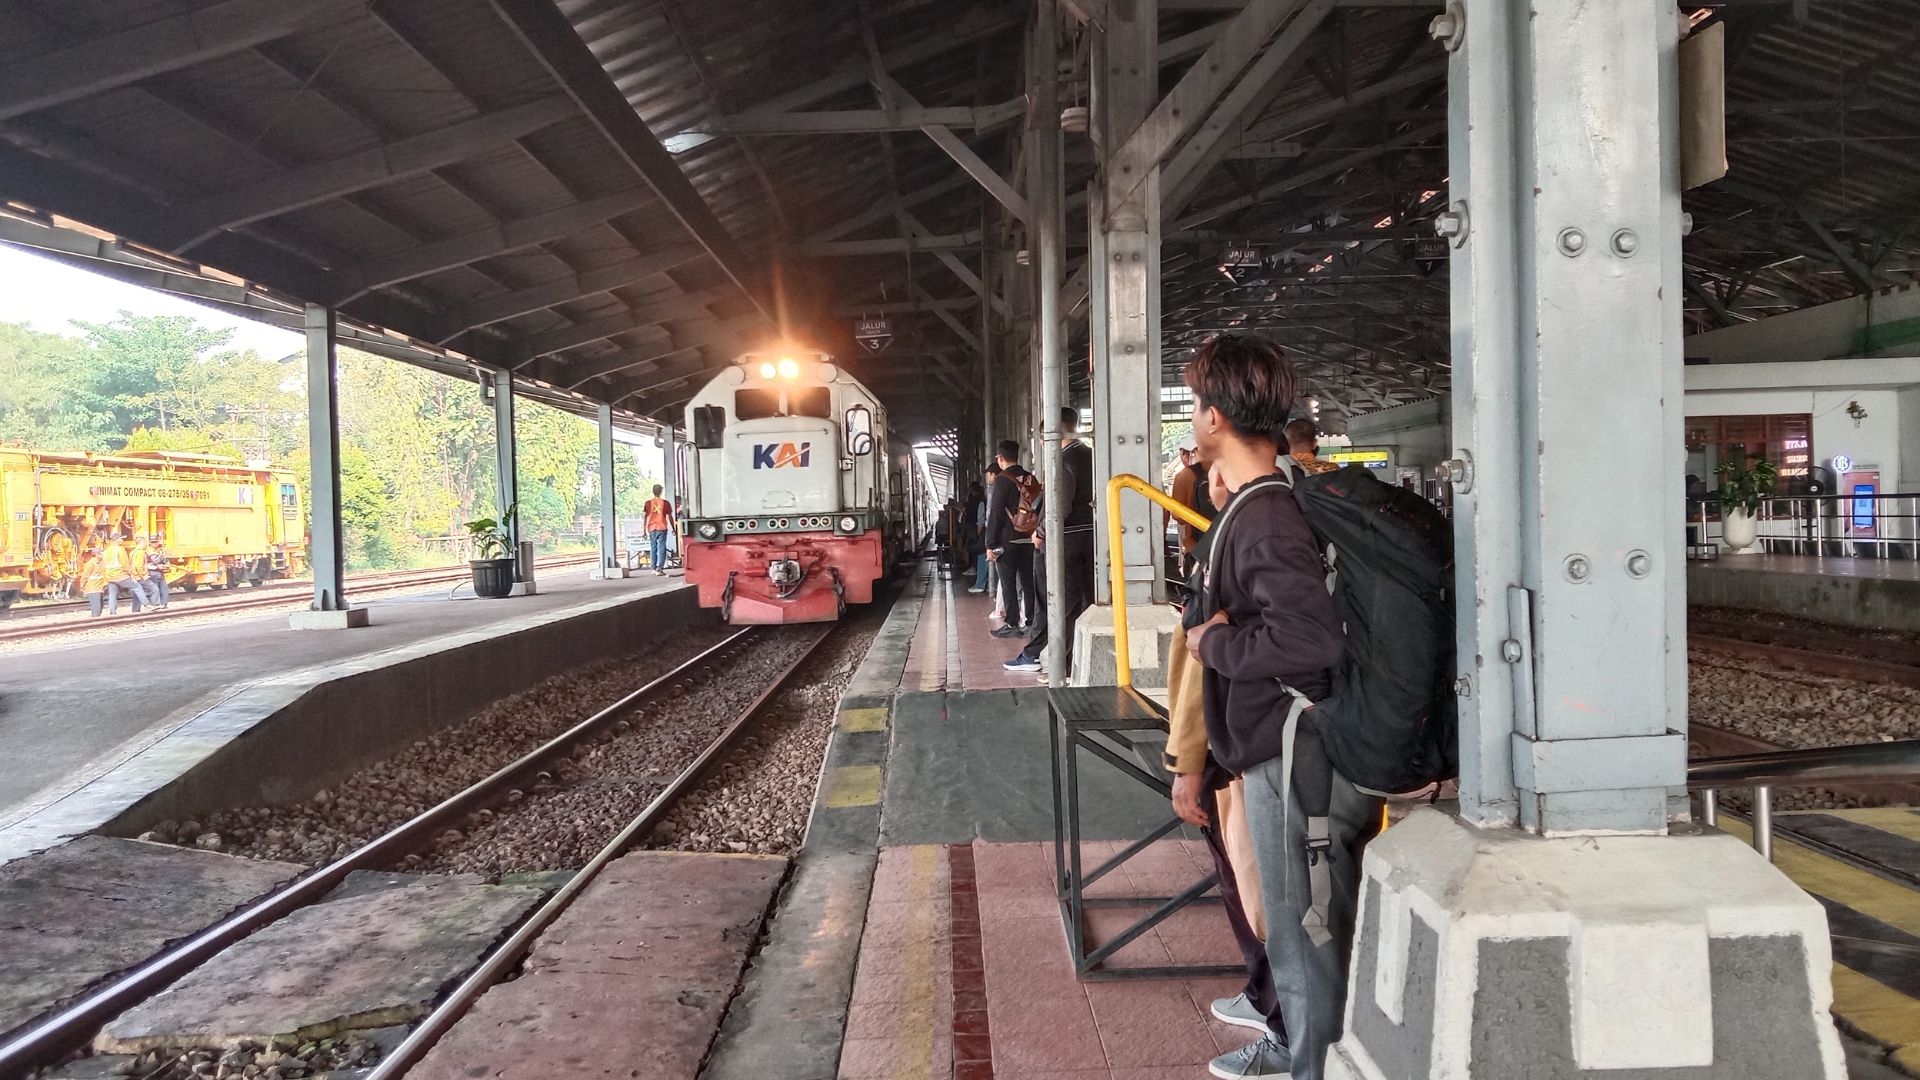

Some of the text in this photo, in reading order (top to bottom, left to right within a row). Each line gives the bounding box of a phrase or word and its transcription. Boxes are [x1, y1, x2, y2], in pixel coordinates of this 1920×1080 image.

[1235, 268, 1245, 278] 2
[860, 321, 886, 330] JALUR
[869, 339, 880, 350] 3
[753, 442, 811, 469] KAI
[123, 487, 156, 498] COMPACT
